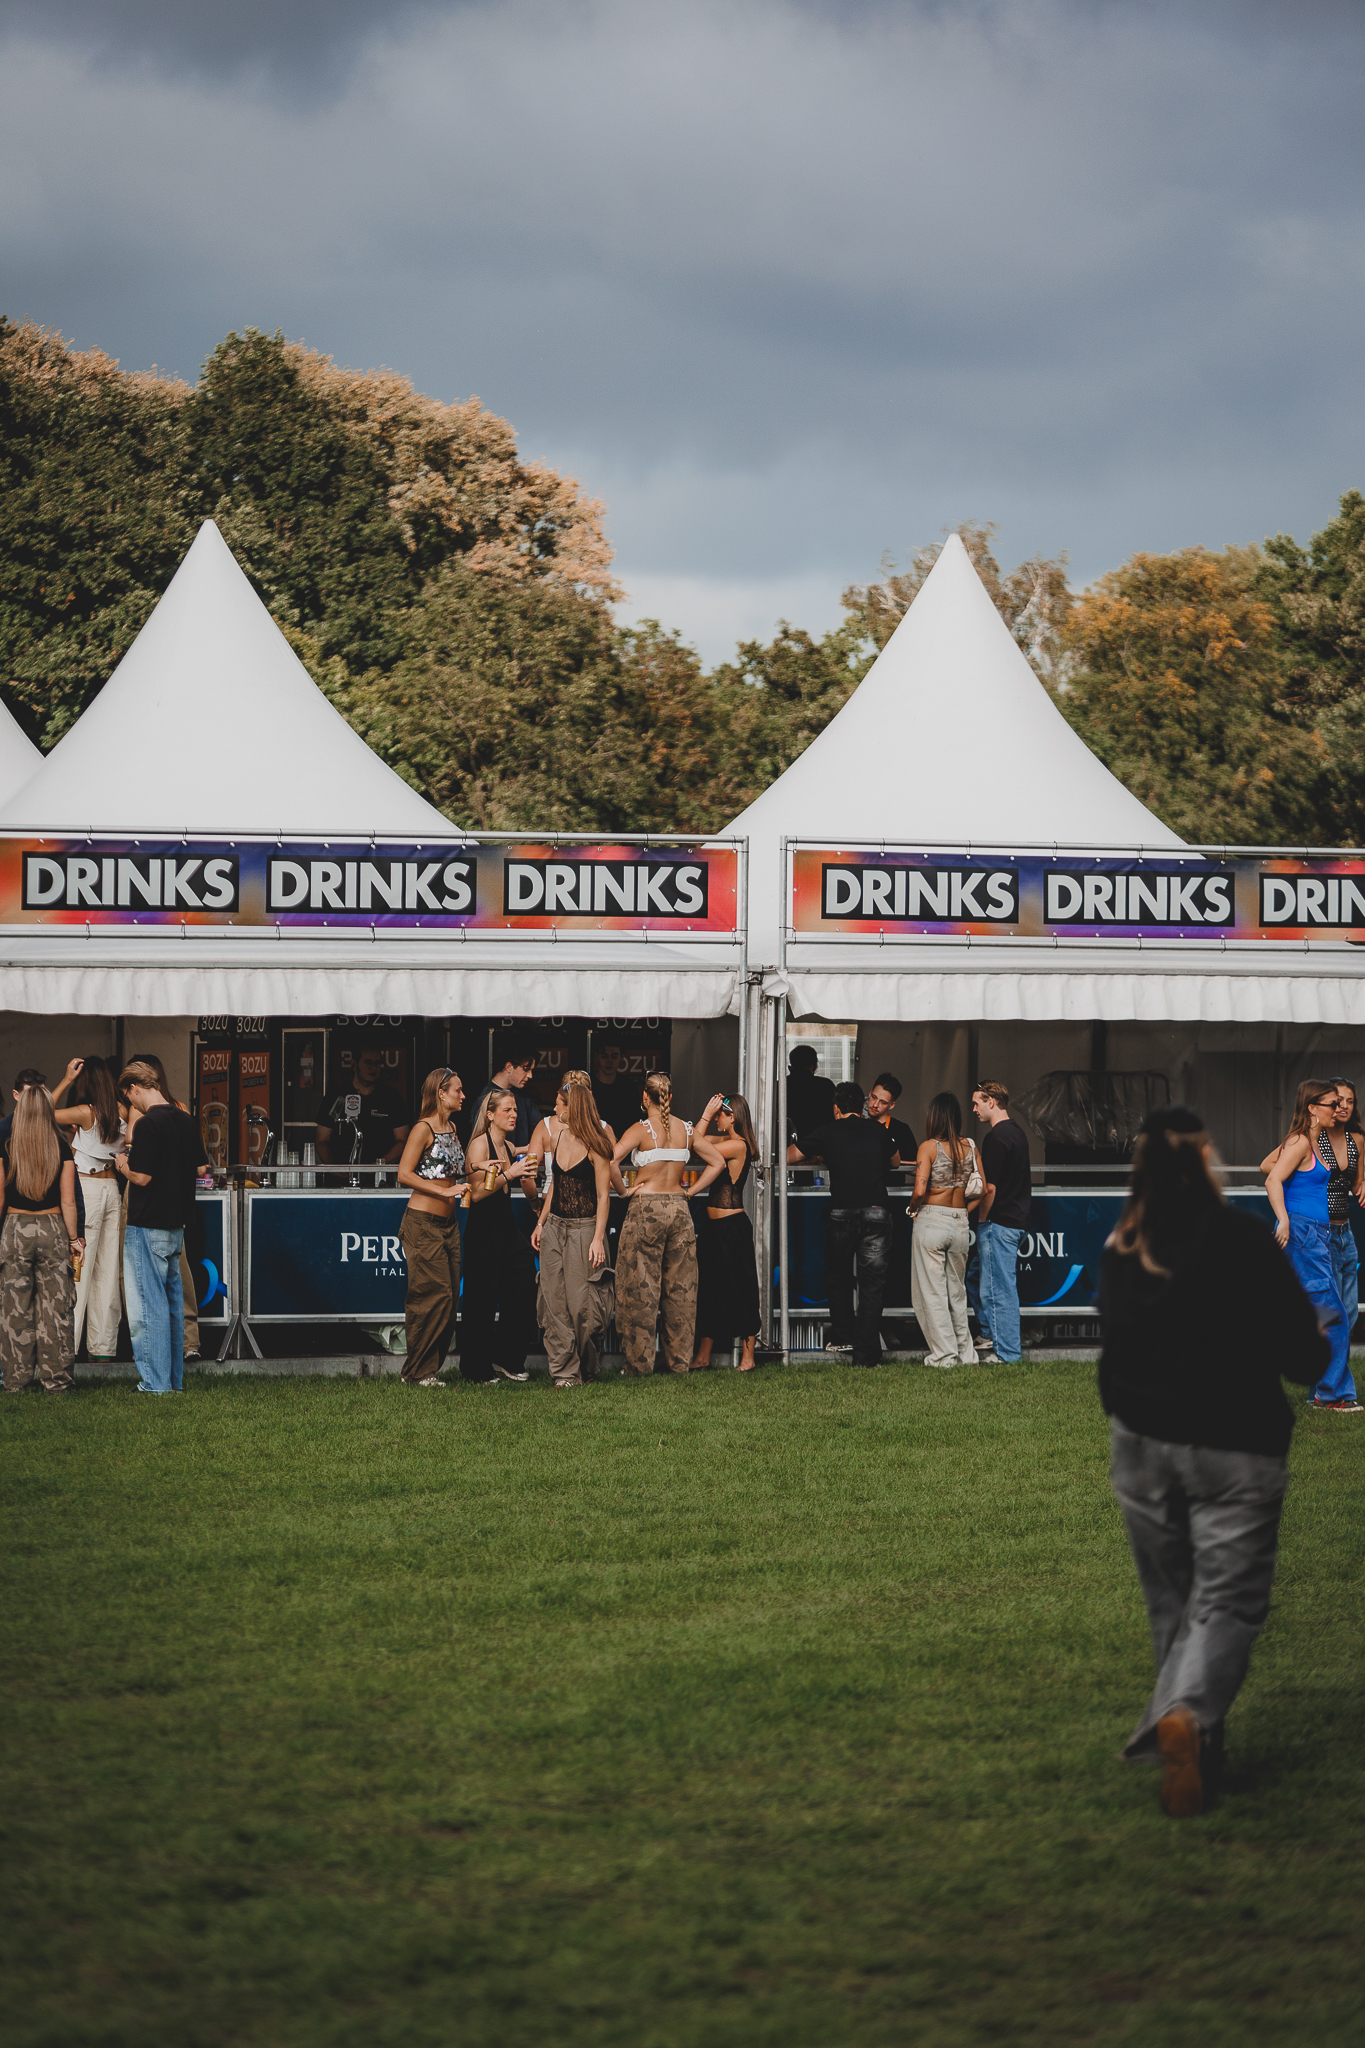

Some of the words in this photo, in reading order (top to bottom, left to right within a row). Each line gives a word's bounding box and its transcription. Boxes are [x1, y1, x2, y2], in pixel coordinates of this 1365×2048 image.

[27, 857, 235, 907] DRINKS
[270, 860, 472, 910] DRINKS
[508, 864, 704, 914] DRINKS
[825, 869, 1015, 918] DRINKS
[1047, 874, 1231, 922] DRINKS
[1263, 878, 1365, 923] DRIN
[201, 1015, 229, 1030] BOZU
[236, 1016, 266, 1033] BOZU
[203, 1053, 229, 1071] BOZU
[241, 1056, 267, 1074] BOZU
[340, 1050, 399, 1068] BU
[536, 1050, 561, 1068] ZU
[617, 1055, 656, 1073] OZU
[340, 1232, 407, 1262] PER
